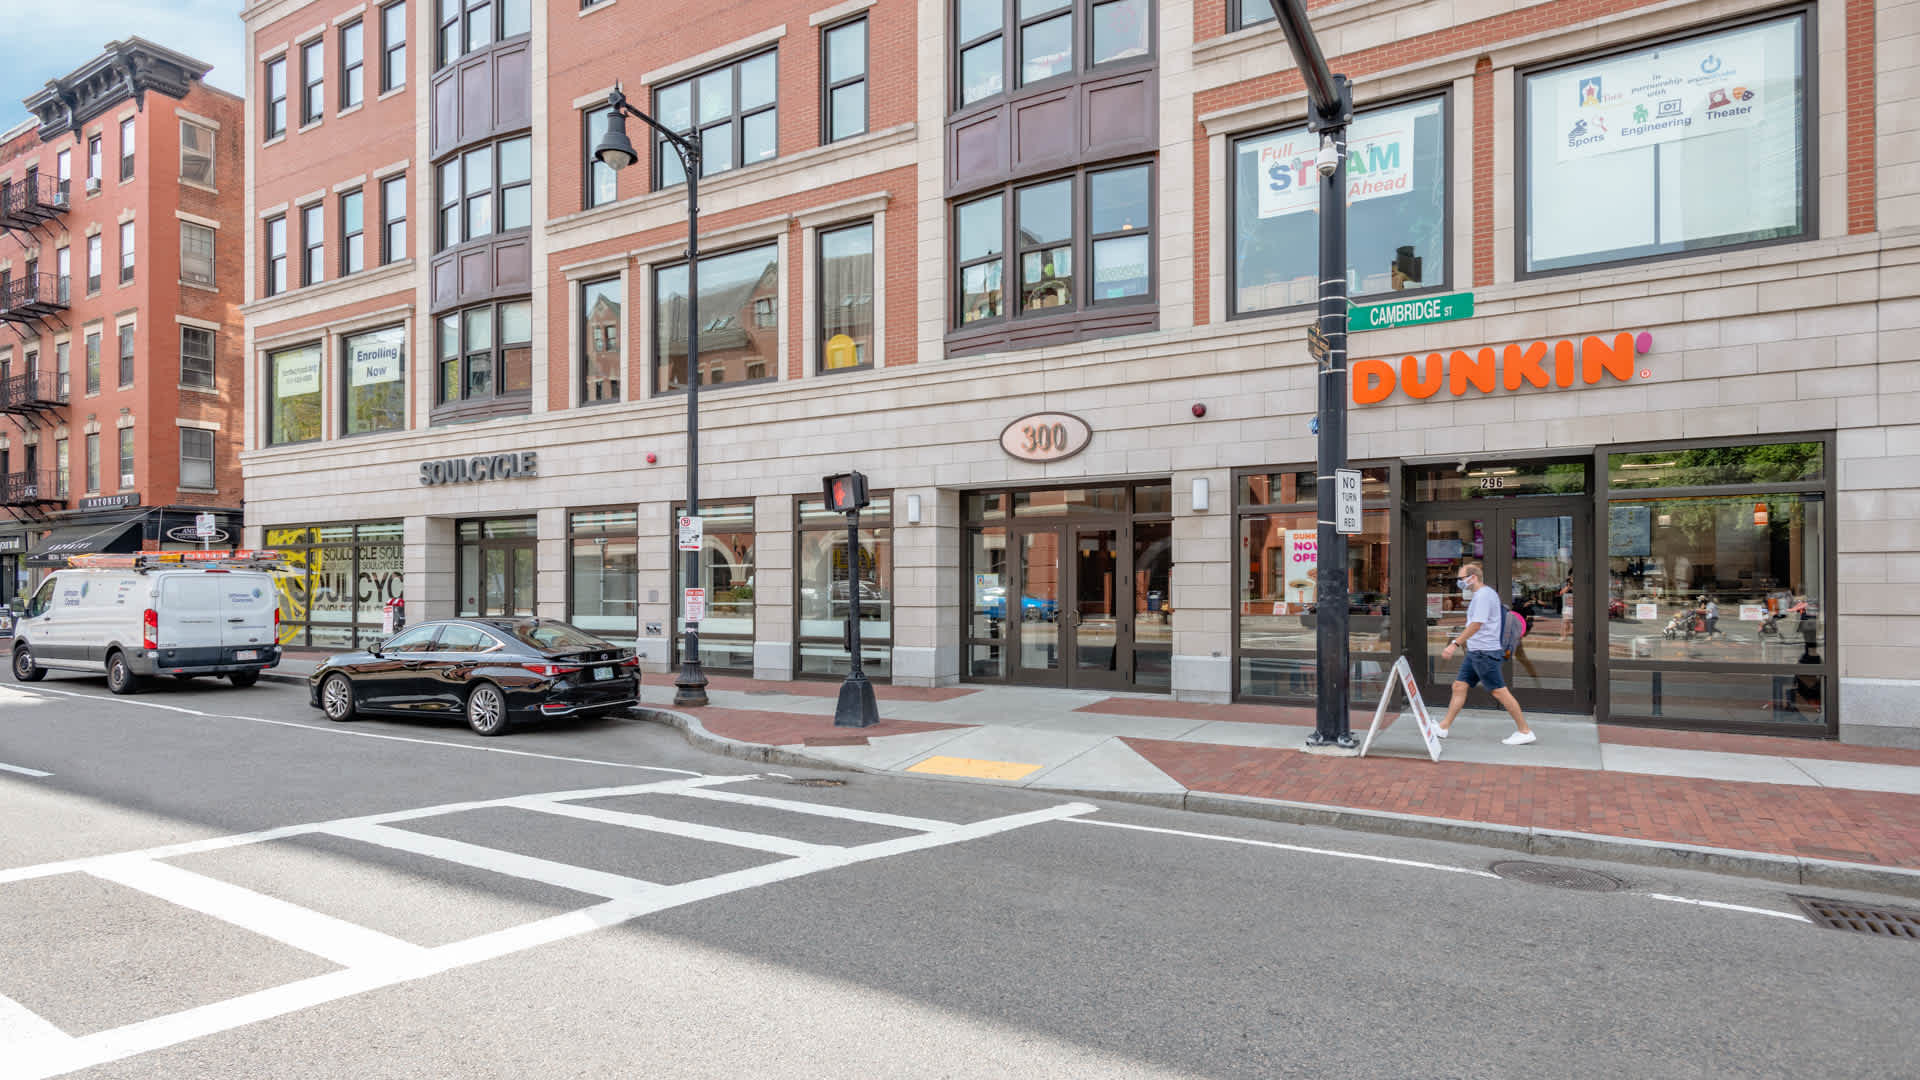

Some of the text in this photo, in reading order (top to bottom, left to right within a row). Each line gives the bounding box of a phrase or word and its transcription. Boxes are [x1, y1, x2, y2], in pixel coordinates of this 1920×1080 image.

[1568, 105, 1752, 148] Sports Engineering Theater
[1262, 143, 1293, 163] Full
[1270, 141, 1400, 191] STAM
[1348, 173, 1408, 196] Ahead
[1370, 299, 1454, 326] CAMBRIDGE ST
[356, 346, 398, 363] Enrolling
[366, 365, 388, 378] Now
[1352, 331, 1653, 406] DUNKIN'
[1021, 421, 1067, 453] 300
[419, 451, 537, 486] SOULCYCLE
[1343, 476, 1356, 489] NO
[1481, 476, 1504, 489] 296
[88, 496, 129, 508] ANTONIO'S
[1345, 504, 1355, 515] ON
[1344, 517, 1356, 528] RED
